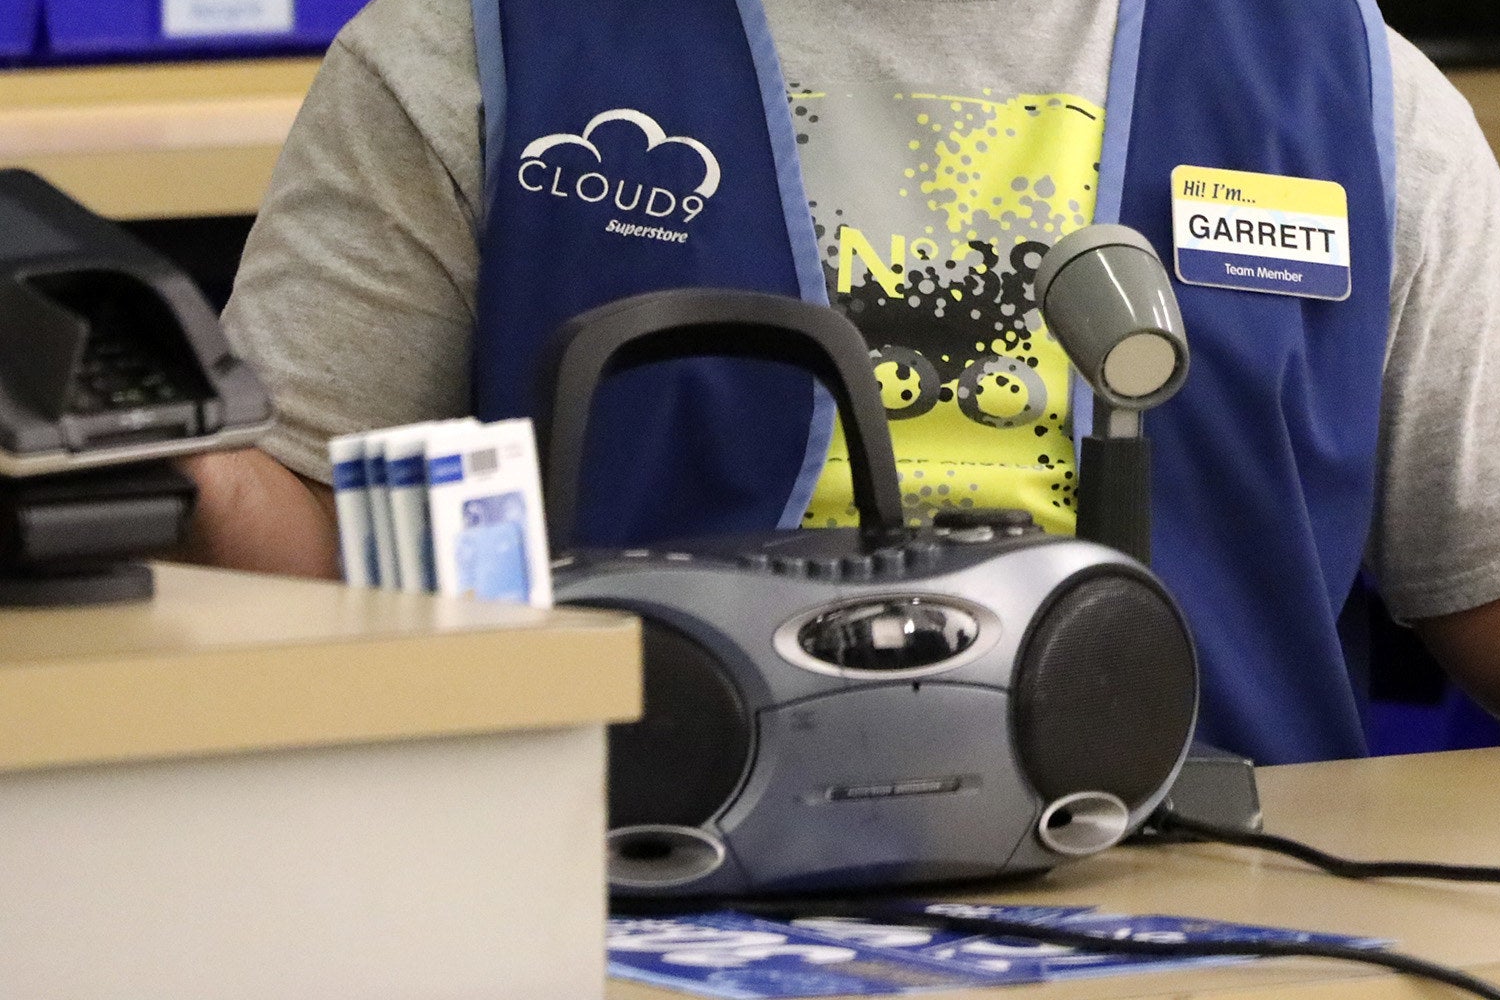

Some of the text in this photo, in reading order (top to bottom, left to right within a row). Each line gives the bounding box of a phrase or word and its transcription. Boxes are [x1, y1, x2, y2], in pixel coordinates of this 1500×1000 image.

[518, 159, 704, 223] CLOUD9
[1183, 180, 1206, 199] Hi!
[605, 219, 688, 243] Superstore
[1189, 214, 1335, 253] GARRETT
[1225, 263, 1303, 282] Team Member
